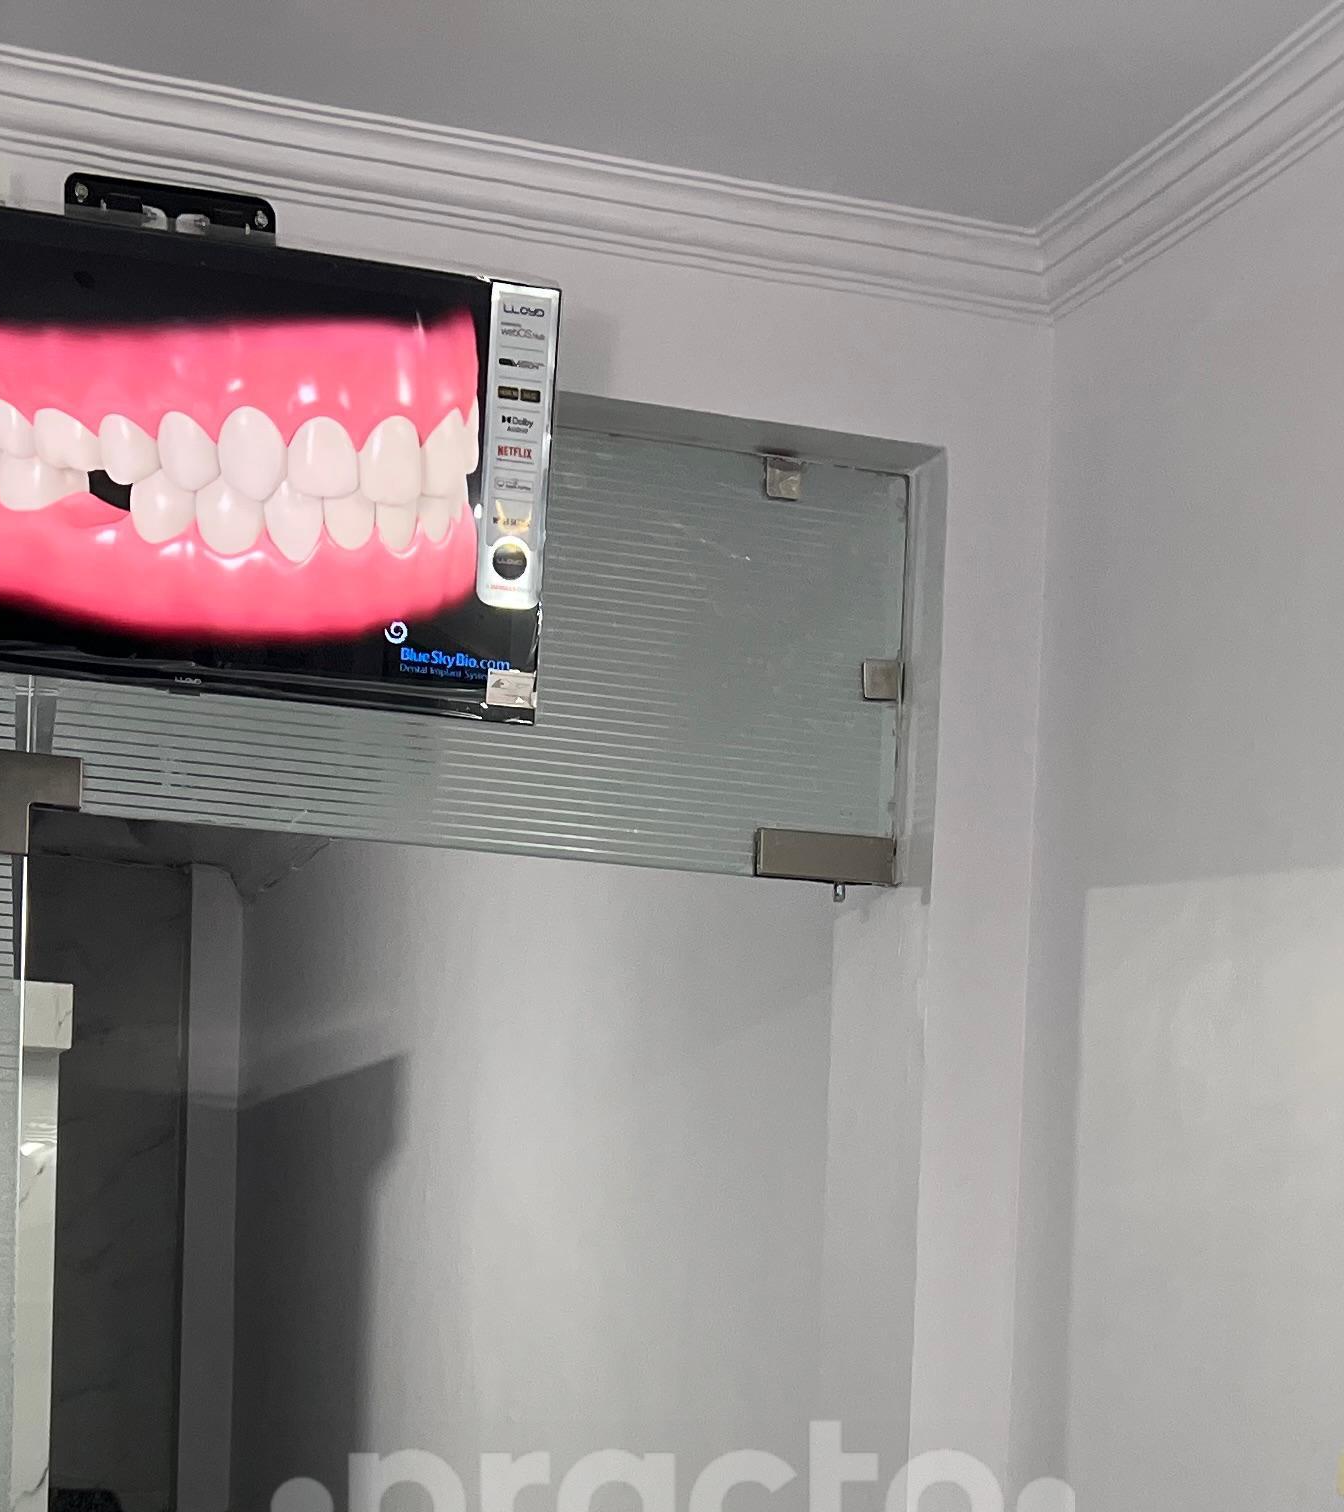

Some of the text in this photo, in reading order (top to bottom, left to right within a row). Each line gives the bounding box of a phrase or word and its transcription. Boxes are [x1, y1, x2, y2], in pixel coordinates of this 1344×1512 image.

[503, 303, 545, 317] LLOYD
[512, 417, 534, 429] Dolby
[497, 445, 532, 459] NETFLIX
[399, 663, 428, 674] Dental
